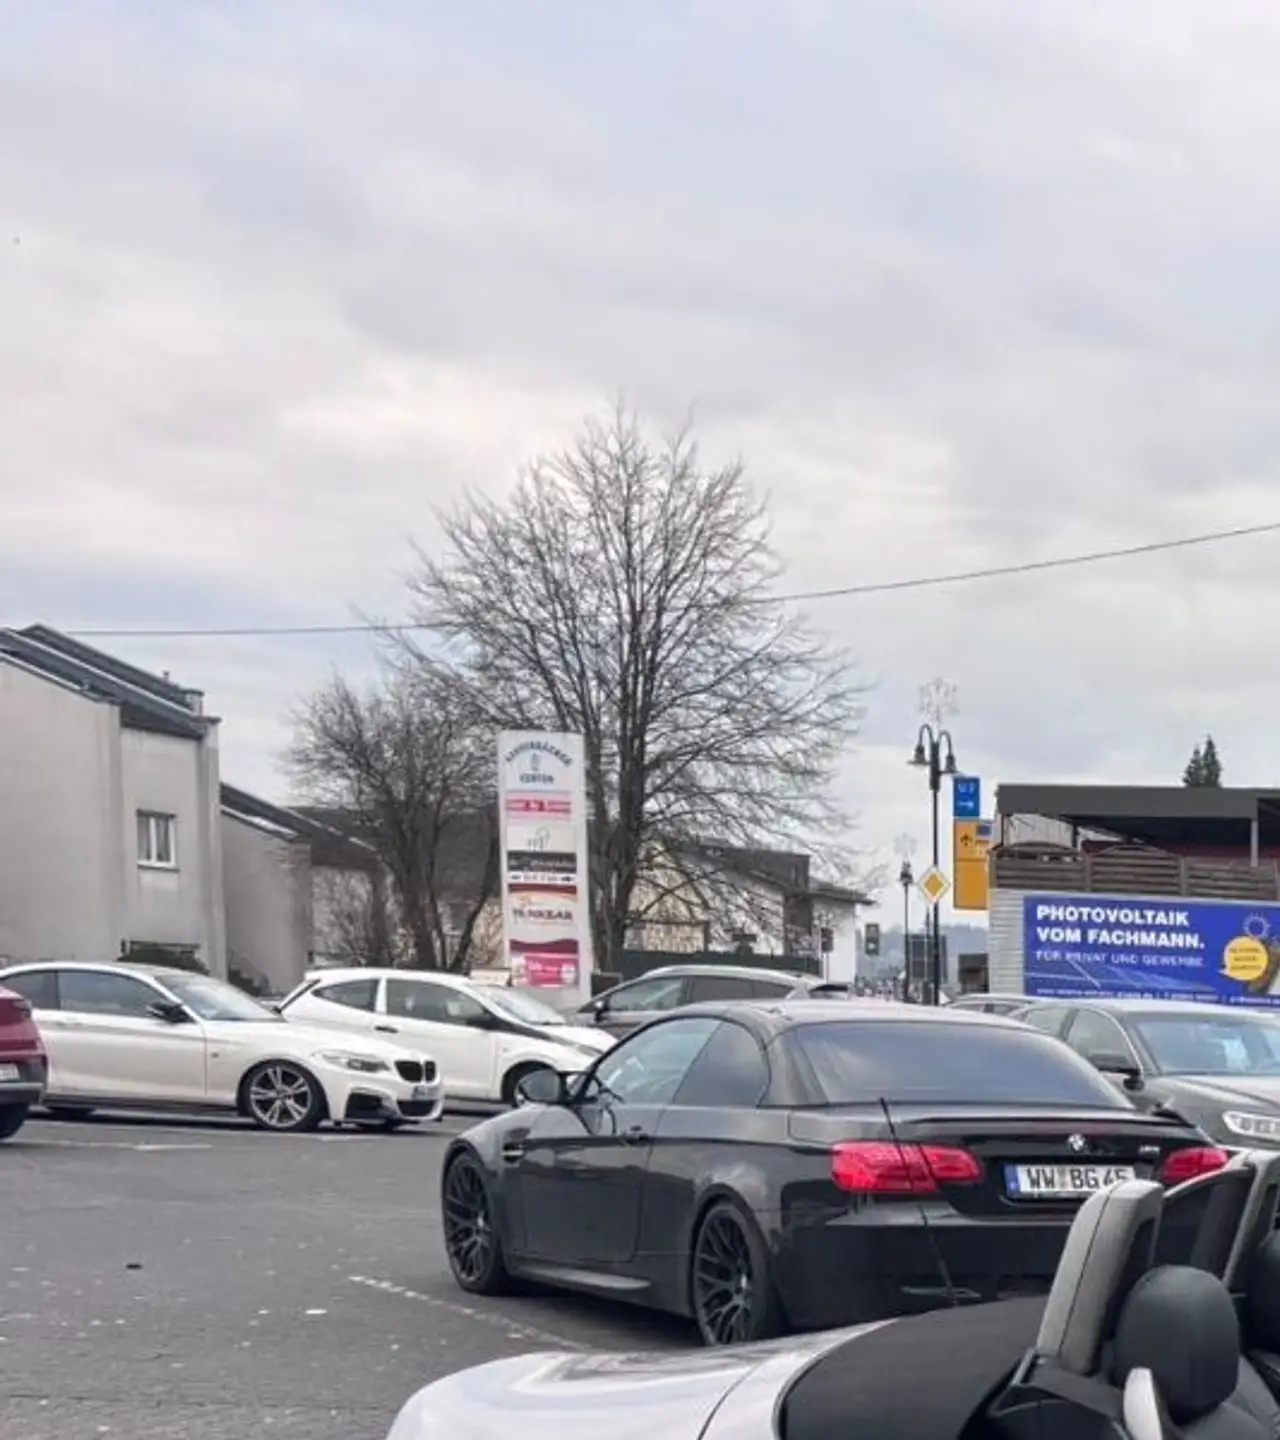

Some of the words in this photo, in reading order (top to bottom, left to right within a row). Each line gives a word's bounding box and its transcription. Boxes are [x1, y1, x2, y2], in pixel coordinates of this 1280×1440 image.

[1036, 904, 1189, 927] PHOTOVOLTAIK
[1036, 927, 1081, 943] VOM
[1087, 928, 1205, 949] FACHMANN.
[1036, 949, 1062, 962] FÜR
[1066, 951, 1106, 964] PRIVAT
[1111, 953, 1138, 966] UND
[1141, 954, 1204, 968] GEWERBE
[1027, 1167, 1055, 1188] WW
[1070, 1168, 1100, 1189] BG
